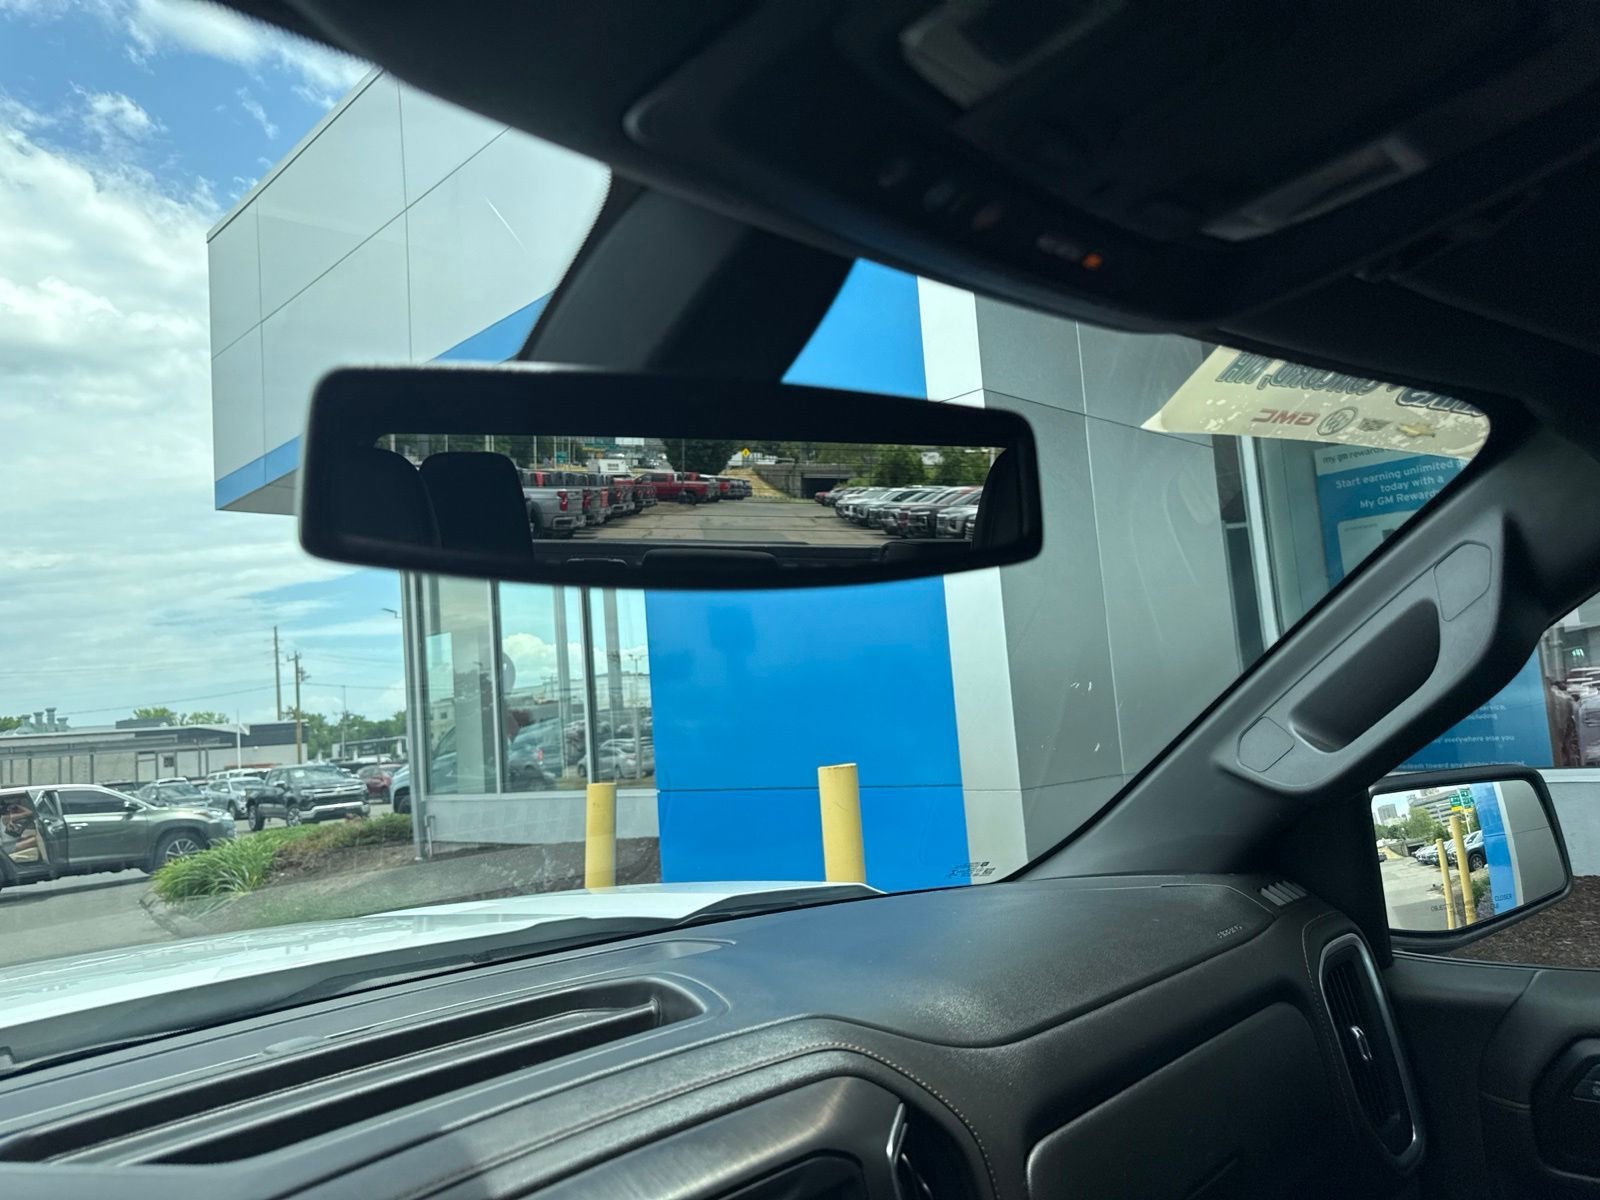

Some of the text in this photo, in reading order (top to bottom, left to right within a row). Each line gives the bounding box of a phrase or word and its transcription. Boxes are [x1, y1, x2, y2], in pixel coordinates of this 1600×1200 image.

[1335, 475, 1361, 490] Start
[1361, 468, 1402, 485] earning
[1403, 459, 1454, 477] unlimited
[1380, 474, 1445, 494] today with a
[1359, 498, 1376, 511] My
[1377, 495, 1395, 506] GM
